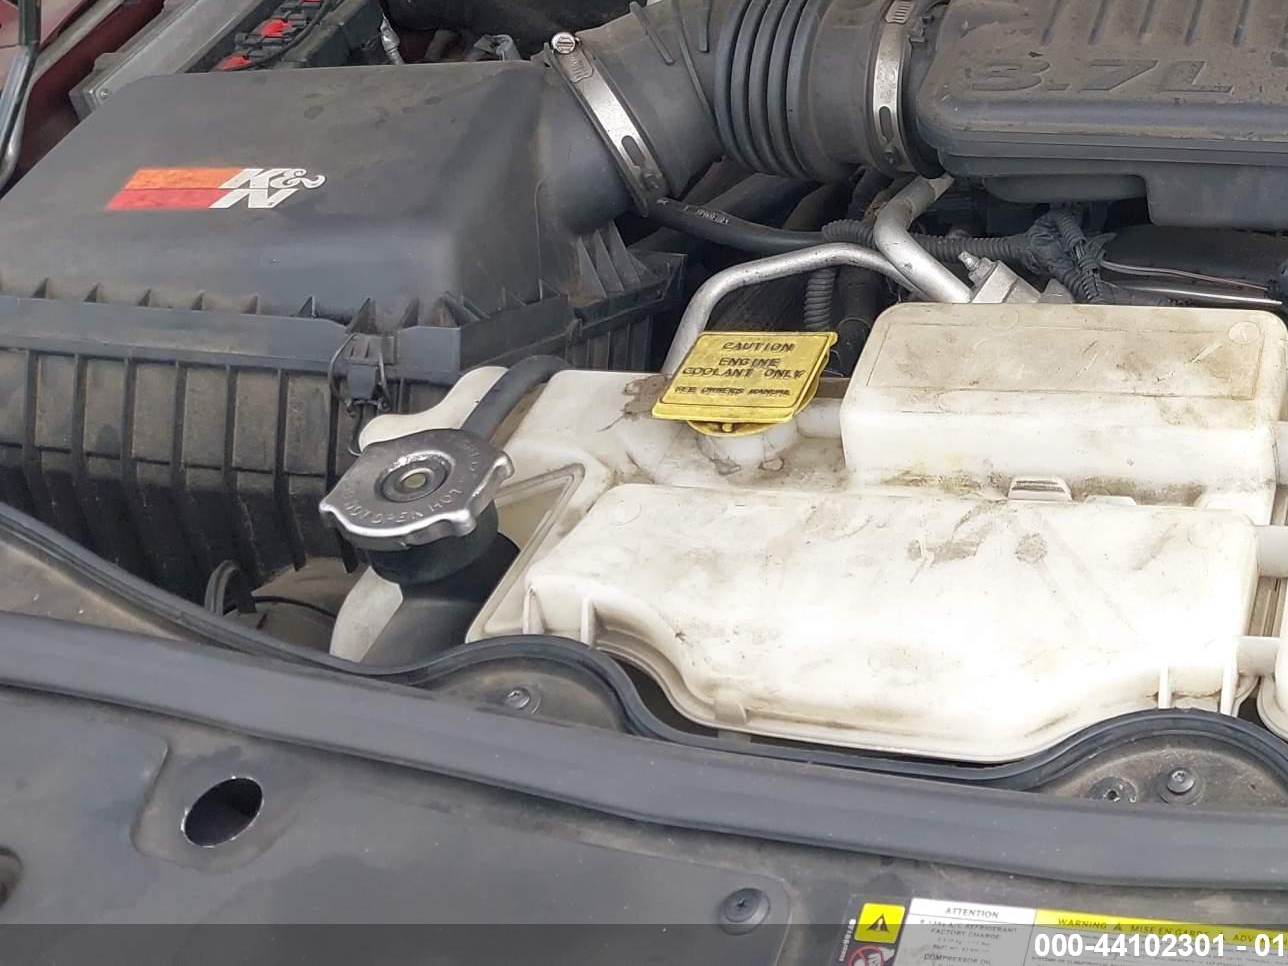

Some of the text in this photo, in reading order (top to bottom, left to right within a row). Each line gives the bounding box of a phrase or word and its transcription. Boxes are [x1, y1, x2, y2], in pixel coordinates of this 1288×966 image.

[971, 58, 1235, 94] 3.7L
[722, 342, 795, 352] CAUTION
[719, 357, 781, 368] ENGINE
[682, 367, 807, 379] COOLANT ONLY
[944, 907, 1000, 920] ATTENTION
[1057, 917, 1108, 931] WARNING
